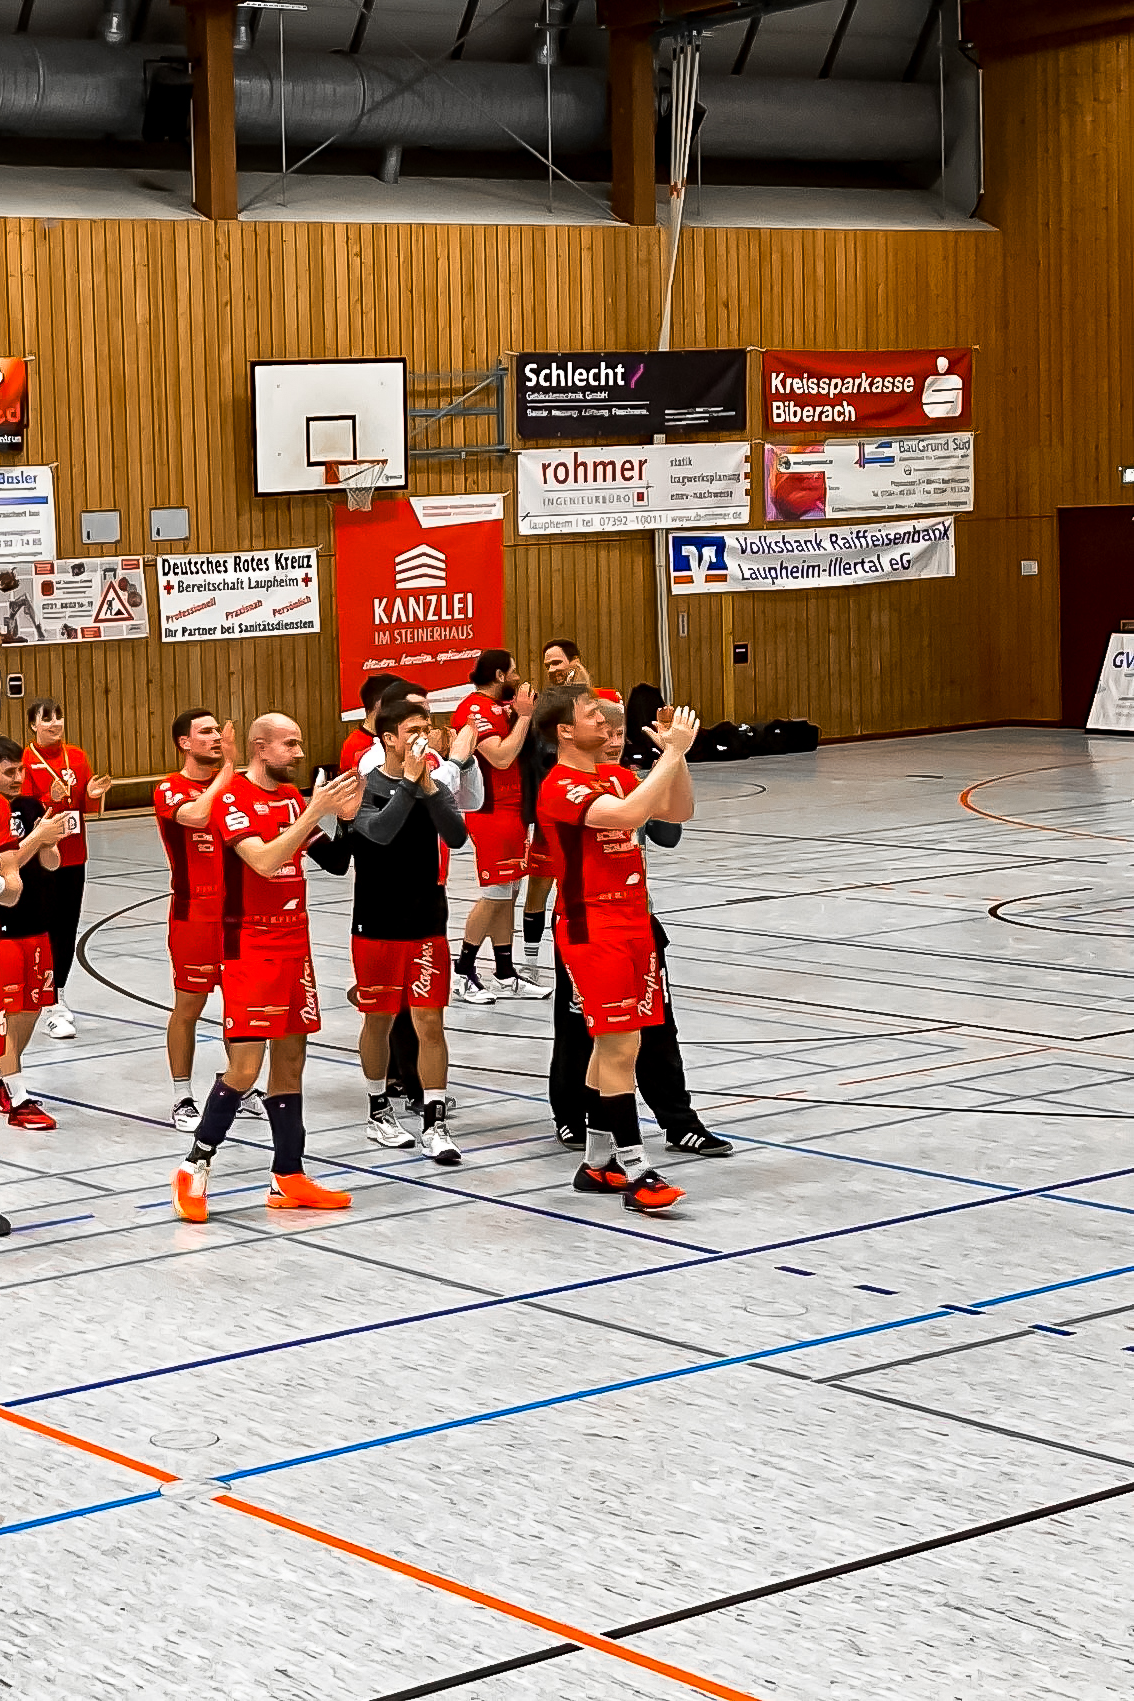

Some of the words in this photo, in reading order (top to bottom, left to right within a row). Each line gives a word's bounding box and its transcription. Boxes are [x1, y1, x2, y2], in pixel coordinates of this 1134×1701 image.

[524, 361, 626, 387] Schlecht
[770, 372, 915, 398] Kreissparkasse
[771, 400, 856, 422] Biberach
[898, 438, 950, 454] BauGrund
[541, 451, 648, 485] rohmer
[542, 493, 631, 507] INGENIEURBÜRO
[528, 518, 573, 532] laupheim
[735, 532, 829, 556] Volksbank
[829, 521, 952, 551] Raiffeisenbank
[161, 557, 229, 577] Deutsches
[233, 555, 270, 573] Rotes
[274, 552, 313, 571] Kreuz
[737, 554, 884, 586] Laupheim-Illertal
[888, 552, 912, 571] eG
[177, 577, 245, 594] Bereitschaft
[247, 574, 299, 592] Laupheim
[165, 596, 217, 625] Professionell
[373, 591, 474, 625] KANZLEI
[164, 627, 179, 639] Ihr
[181, 625, 217, 638] Partner
[220, 622, 235, 635] bei
[237, 619, 315, 635] Sanitätsdiensten
[374, 630, 391, 646] IM
[394, 624, 474, 645] STEINERHAUS
